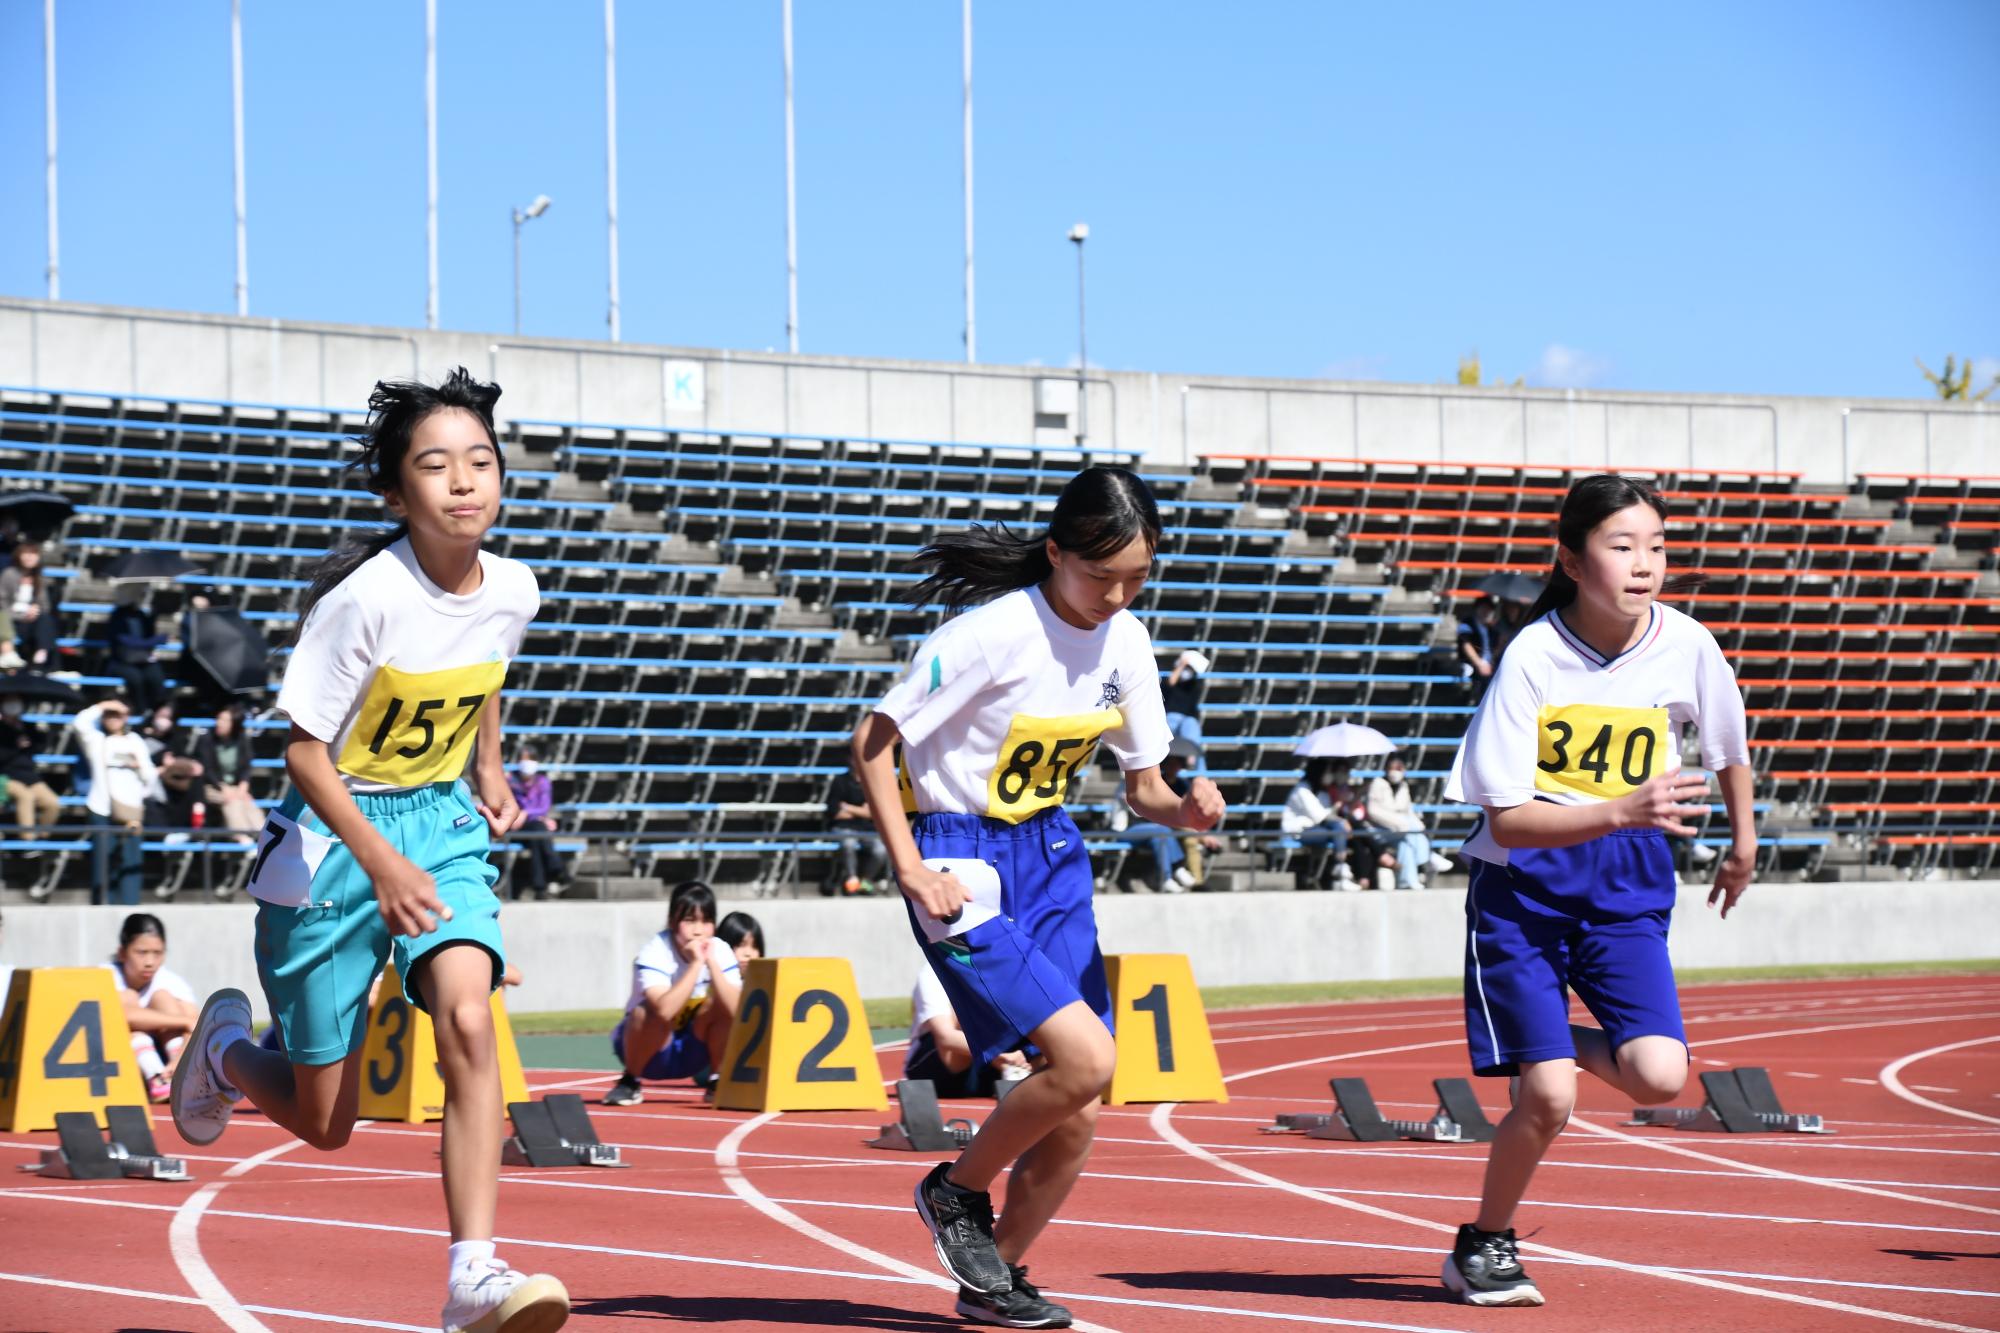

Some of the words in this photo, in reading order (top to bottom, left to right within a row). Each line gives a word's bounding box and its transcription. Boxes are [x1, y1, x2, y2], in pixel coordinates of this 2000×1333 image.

[673, 369, 693, 400] K
[369, 694, 485, 758] 157
[1537, 721, 1655, 785] 340
[252, 820, 287, 884] 7
[43, 1001, 119, 1096] 4
[368, 997, 408, 1095] 3
[731, 989, 770, 1082] 2
[792, 989, 856, 1082] 2
[1132, 984, 1175, 1072] 1
